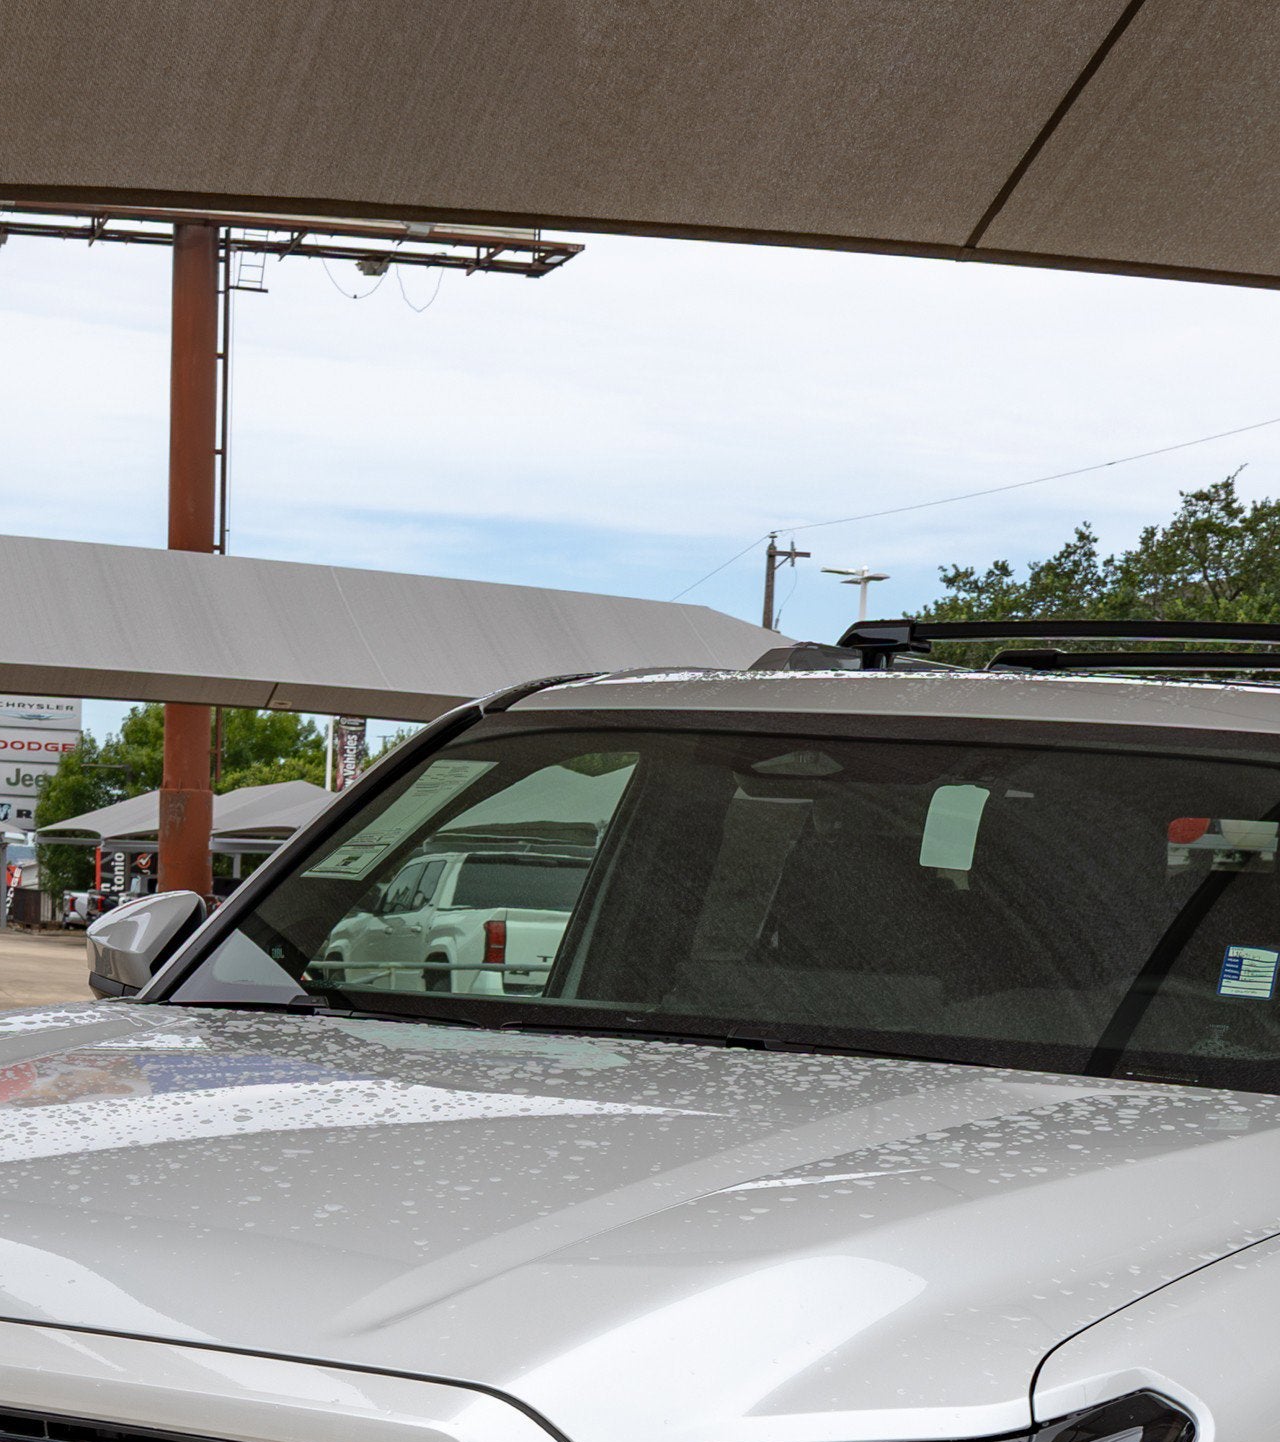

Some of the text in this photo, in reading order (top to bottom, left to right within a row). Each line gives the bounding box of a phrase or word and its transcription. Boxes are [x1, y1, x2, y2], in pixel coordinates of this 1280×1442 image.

[343, 734, 358, 777] Vehicles
[6, 768, 49, 788] Jee
[111, 852, 125, 892] tonio
